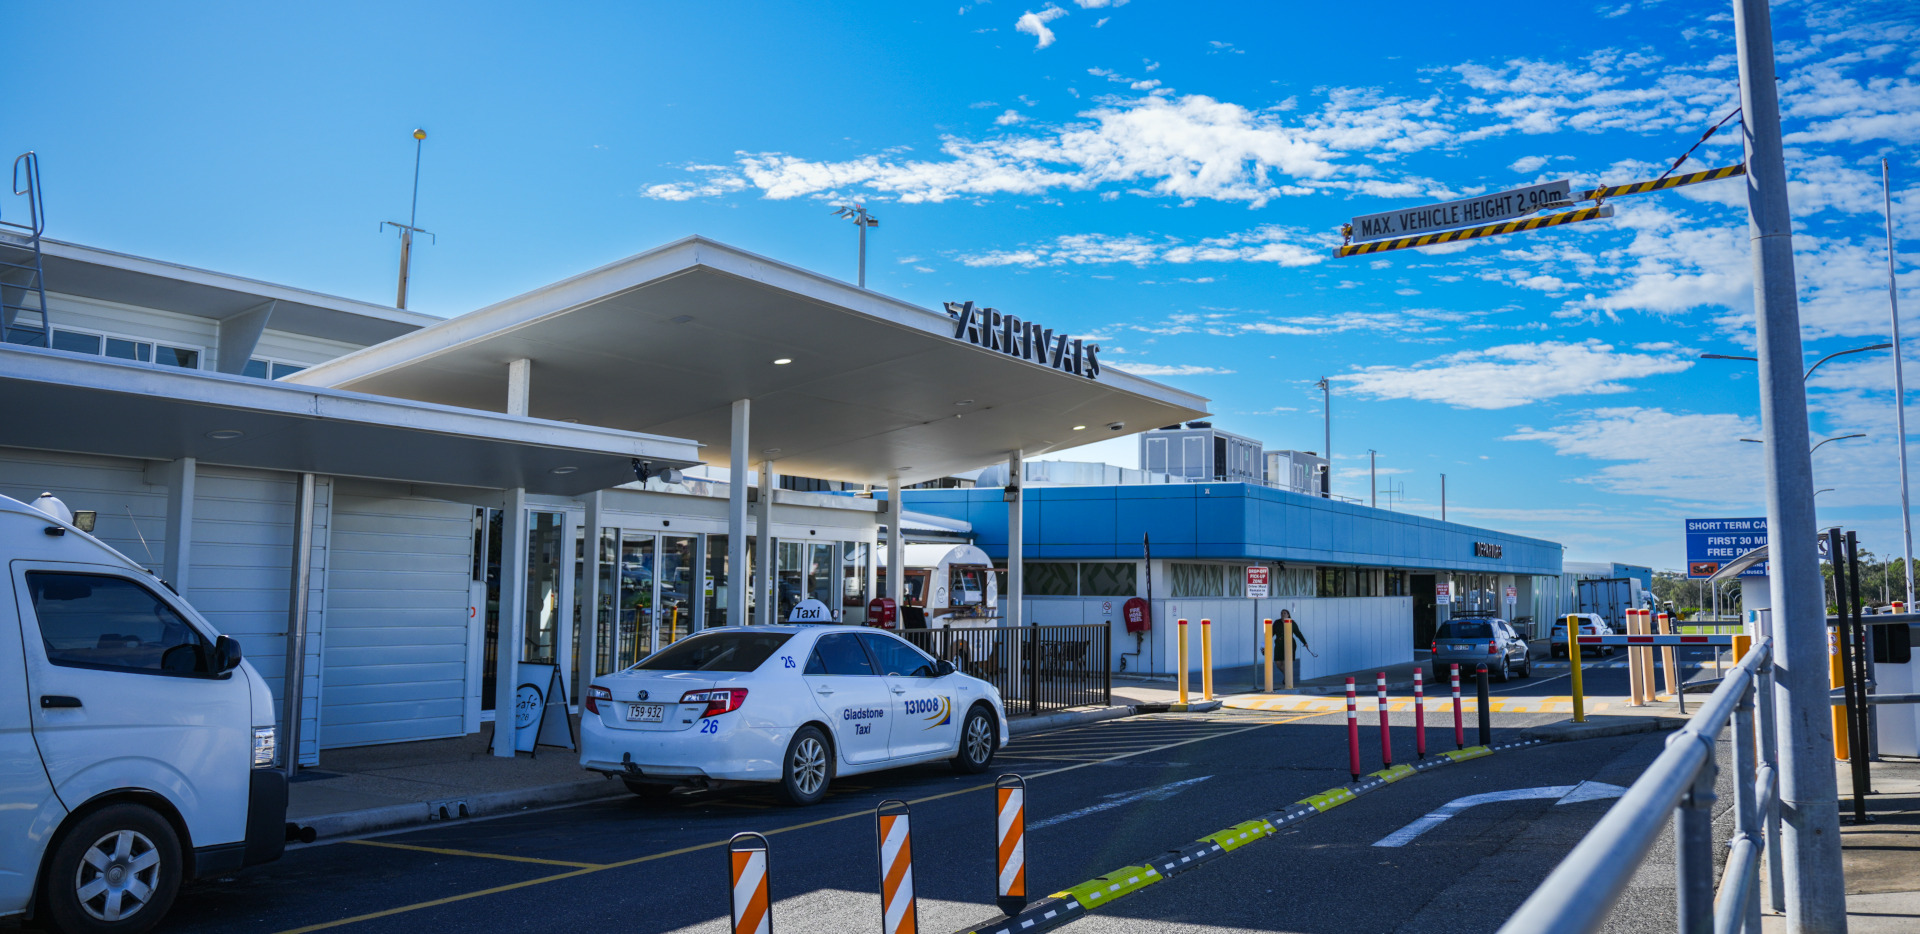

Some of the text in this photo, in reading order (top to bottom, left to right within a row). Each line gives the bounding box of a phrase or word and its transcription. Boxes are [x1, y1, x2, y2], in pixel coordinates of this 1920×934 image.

[1362, 189, 1562, 237] MAX. VEHICLE HEIGHT 2.90m
[955, 301, 1101, 380] ARRIVALS
[1688, 521, 1768, 531] SHORT TERM CA
[1707, 536, 1769, 545] FIRST 30 MI
[1707, 548, 1734, 557] FREE
[795, 606, 821, 620] Taxi
[781, 655, 796, 669] 26
[904, 697, 939, 715] 131008
[843, 708, 884, 721] Gladstone
[700, 719, 719, 734] 26
[855, 723, 871, 736] Taxi
